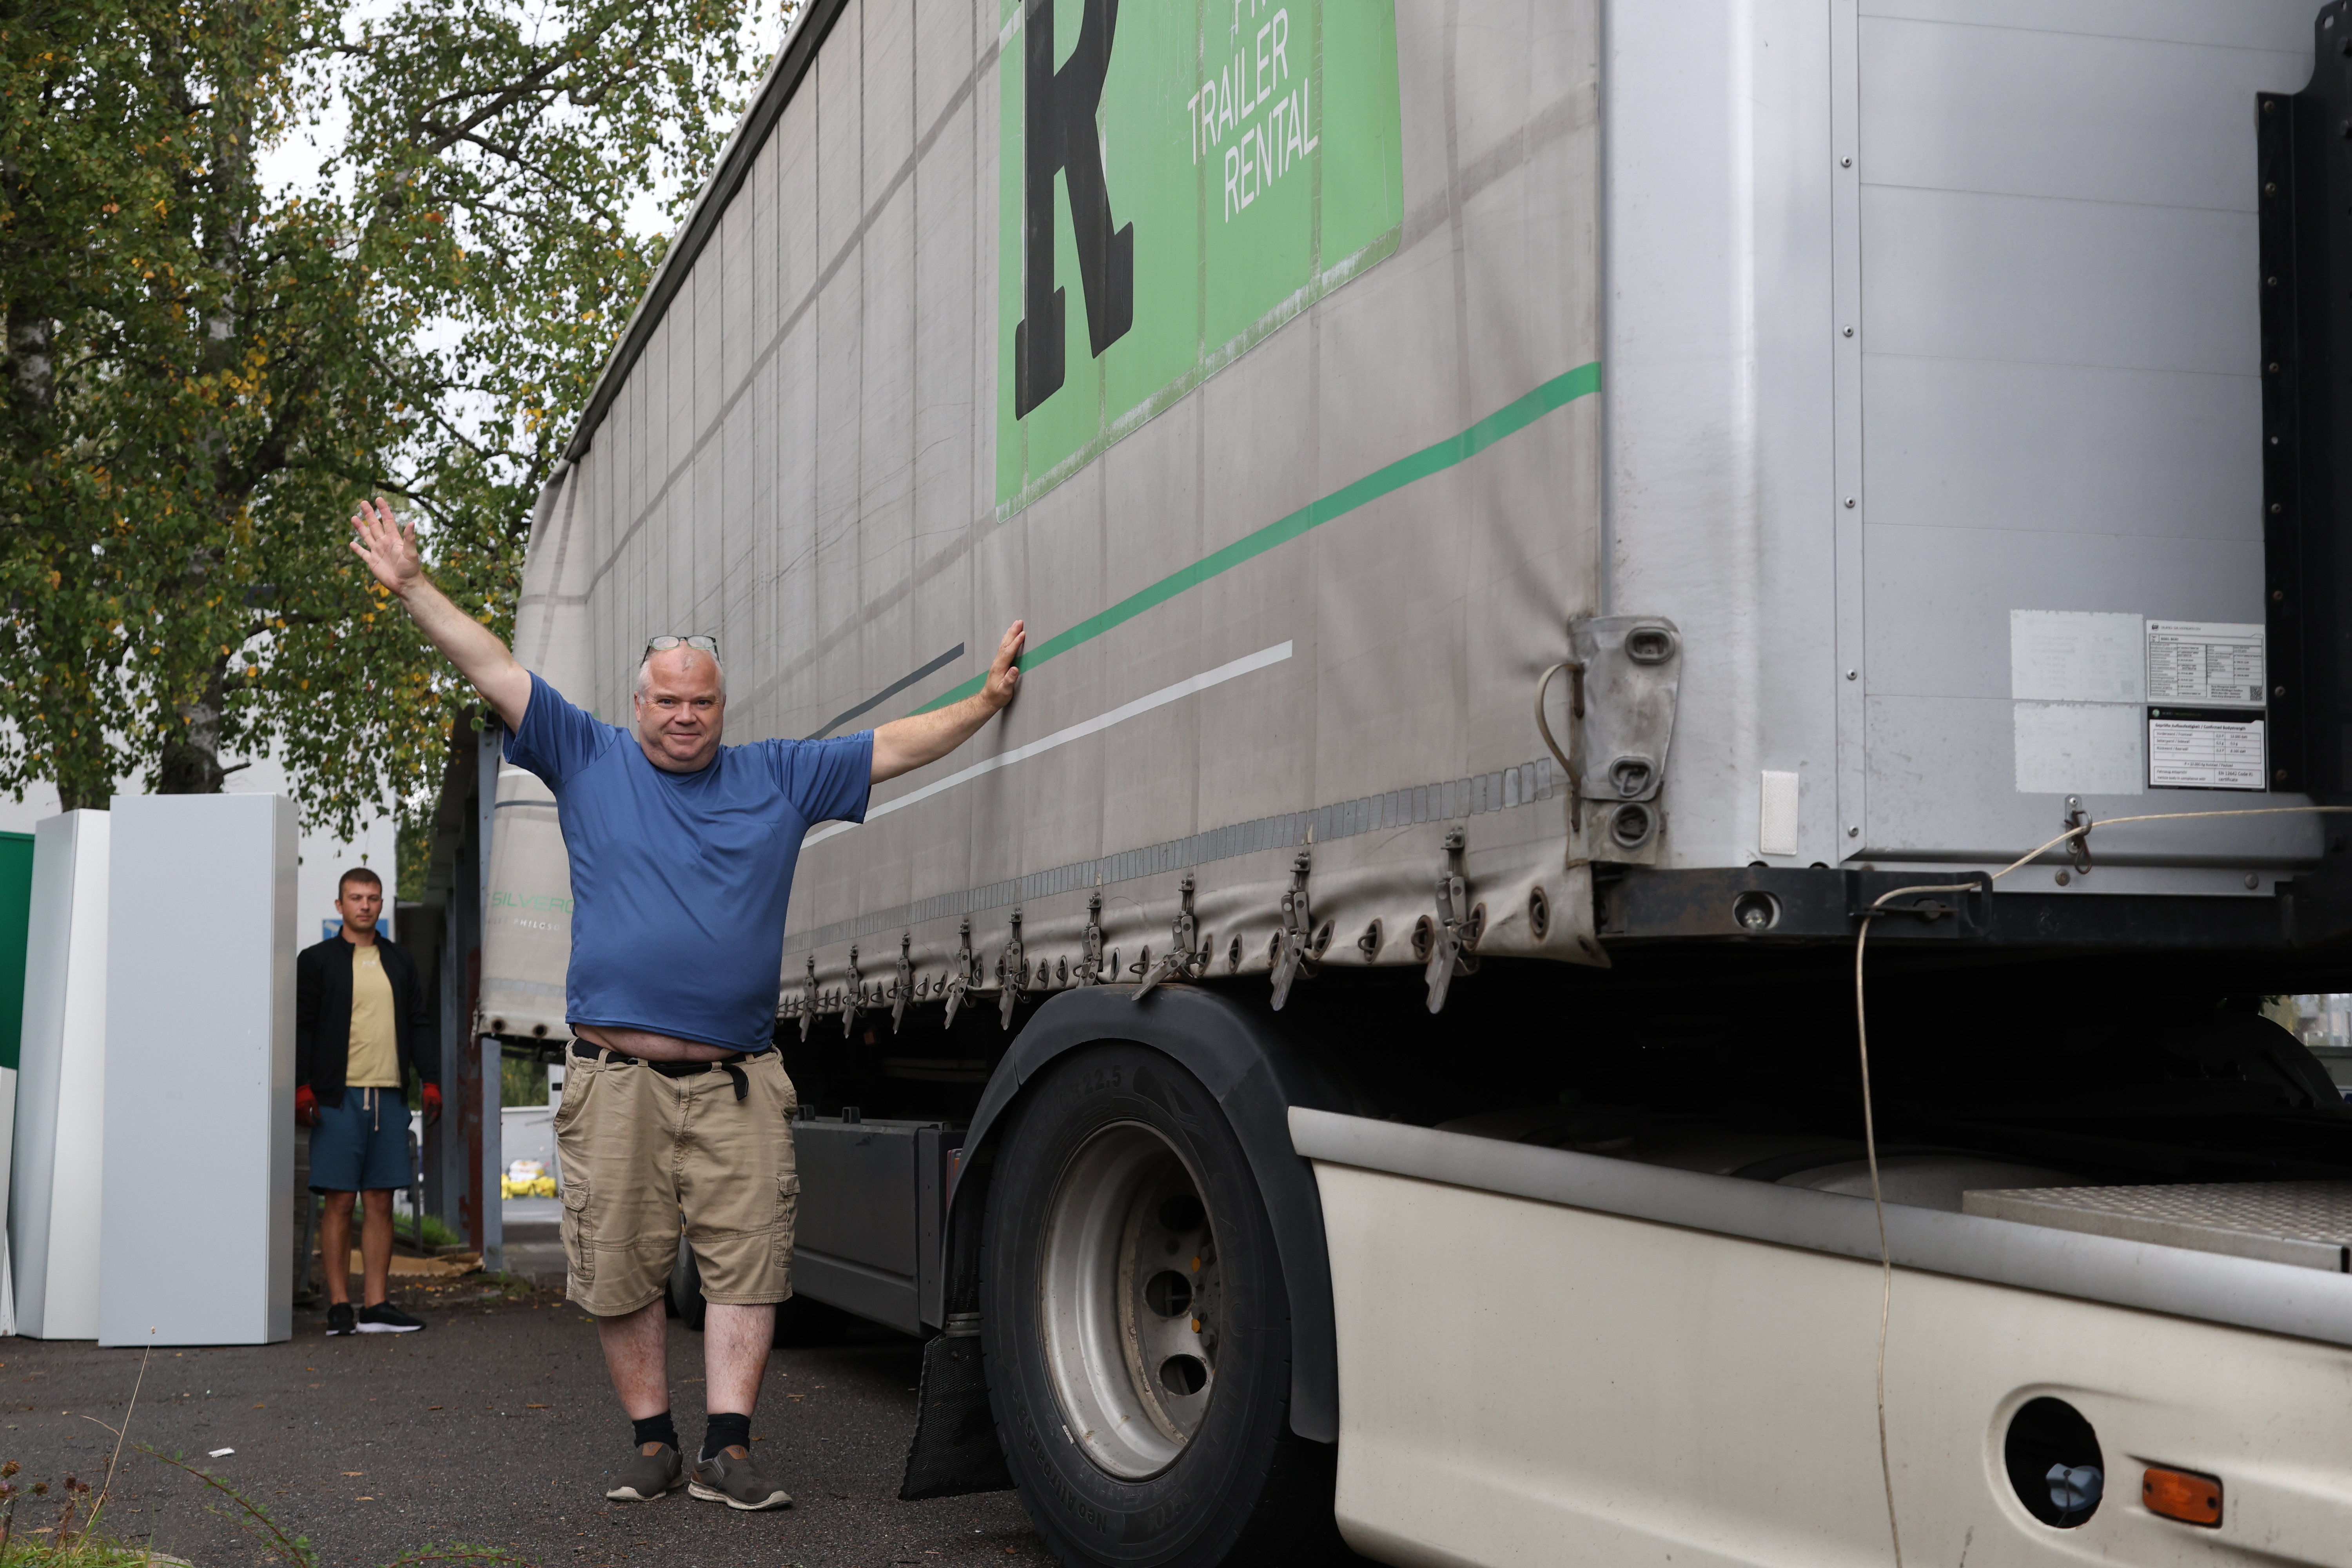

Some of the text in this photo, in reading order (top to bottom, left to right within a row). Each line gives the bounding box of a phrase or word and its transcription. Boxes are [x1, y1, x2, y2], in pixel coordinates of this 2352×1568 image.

[1187, 8, 1289, 165] TRAILER
[1225, 78, 1319, 223] RENTAL
[1024, 1421, 1078, 1512] Allroads
[1078, 1502, 1107, 1534] Neo
